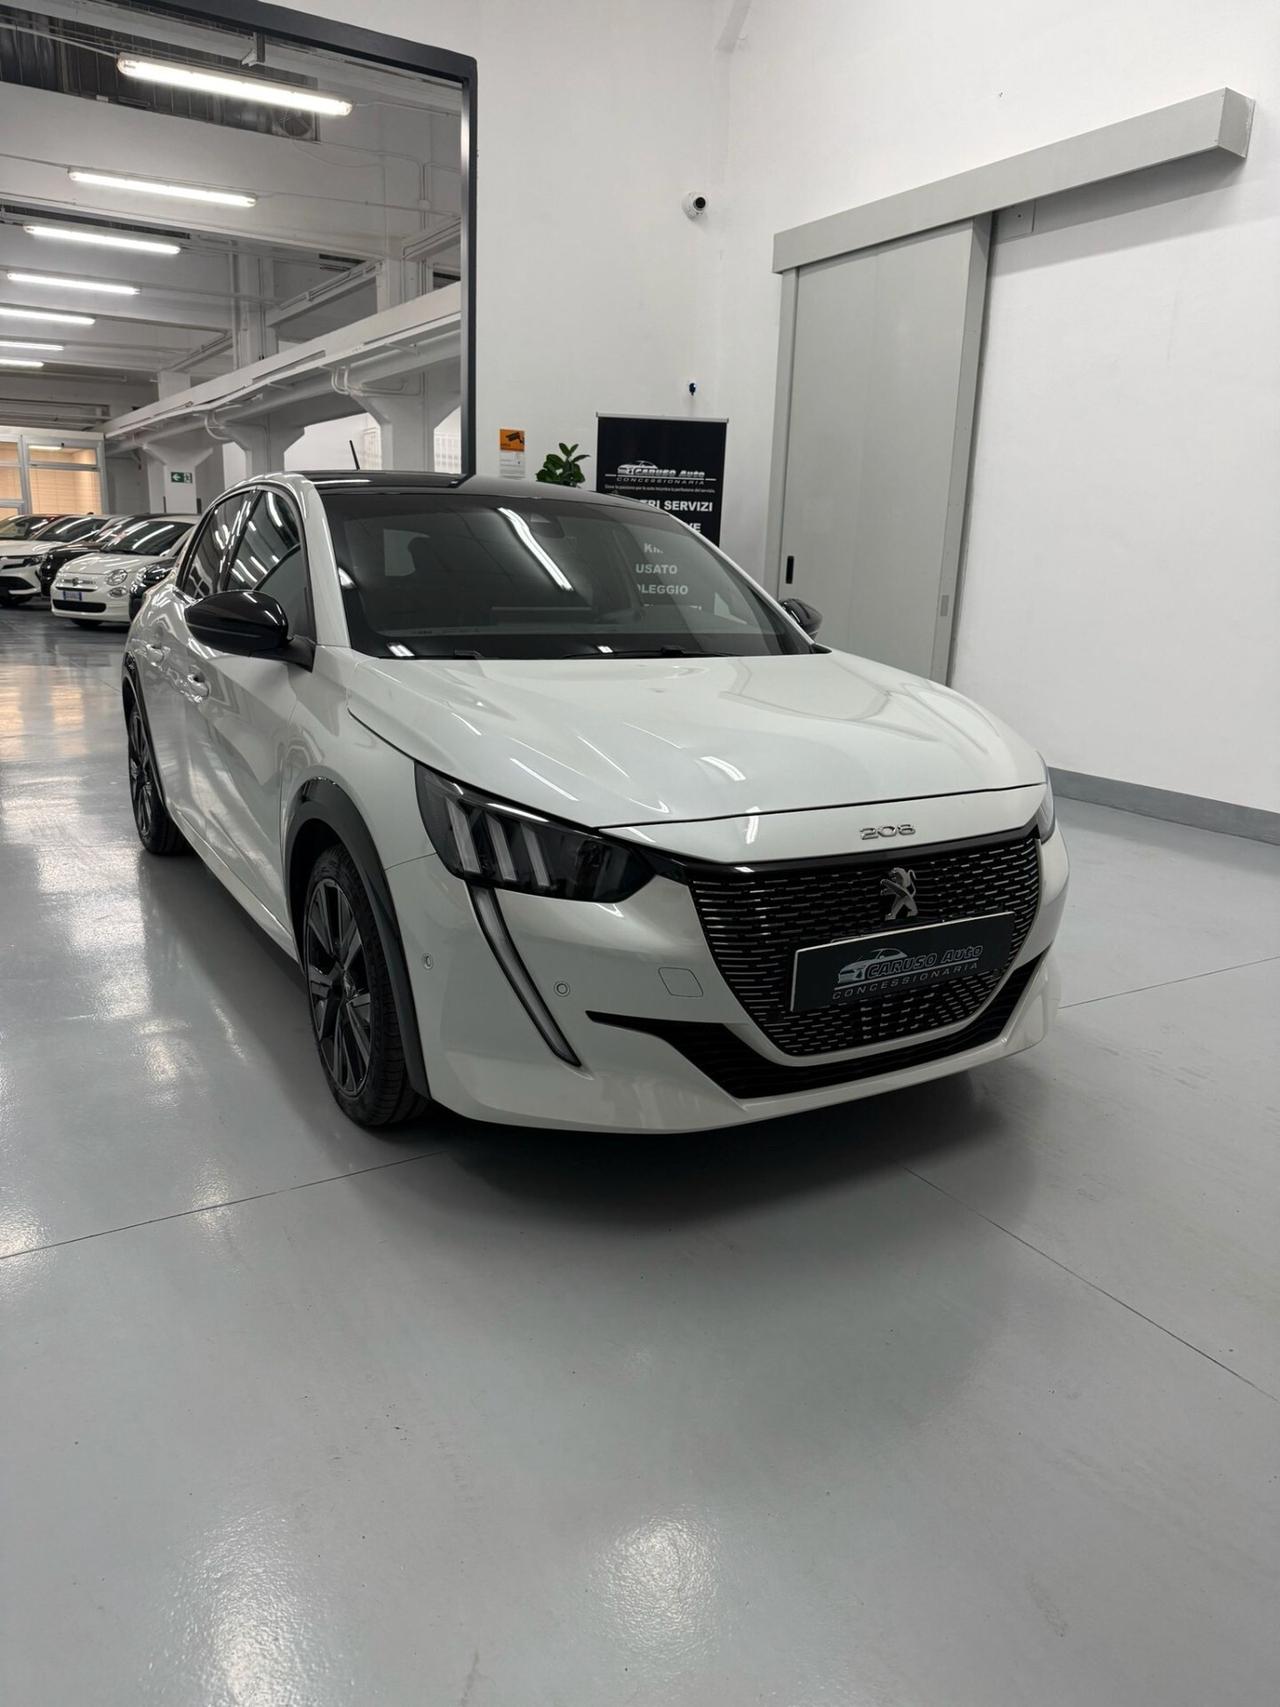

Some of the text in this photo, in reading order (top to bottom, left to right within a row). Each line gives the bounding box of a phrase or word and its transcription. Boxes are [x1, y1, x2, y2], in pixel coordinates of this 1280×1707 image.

[616, 477, 706, 486] CONCESSIONARIA
[664, 500, 713, 512] SERVIZI
[635, 563, 678, 575] USATO
[859, 823, 916, 840] 208
[866, 945, 984, 979] CARUSO Auto
[832, 962, 978, 1000] CONCESSIONARIA
